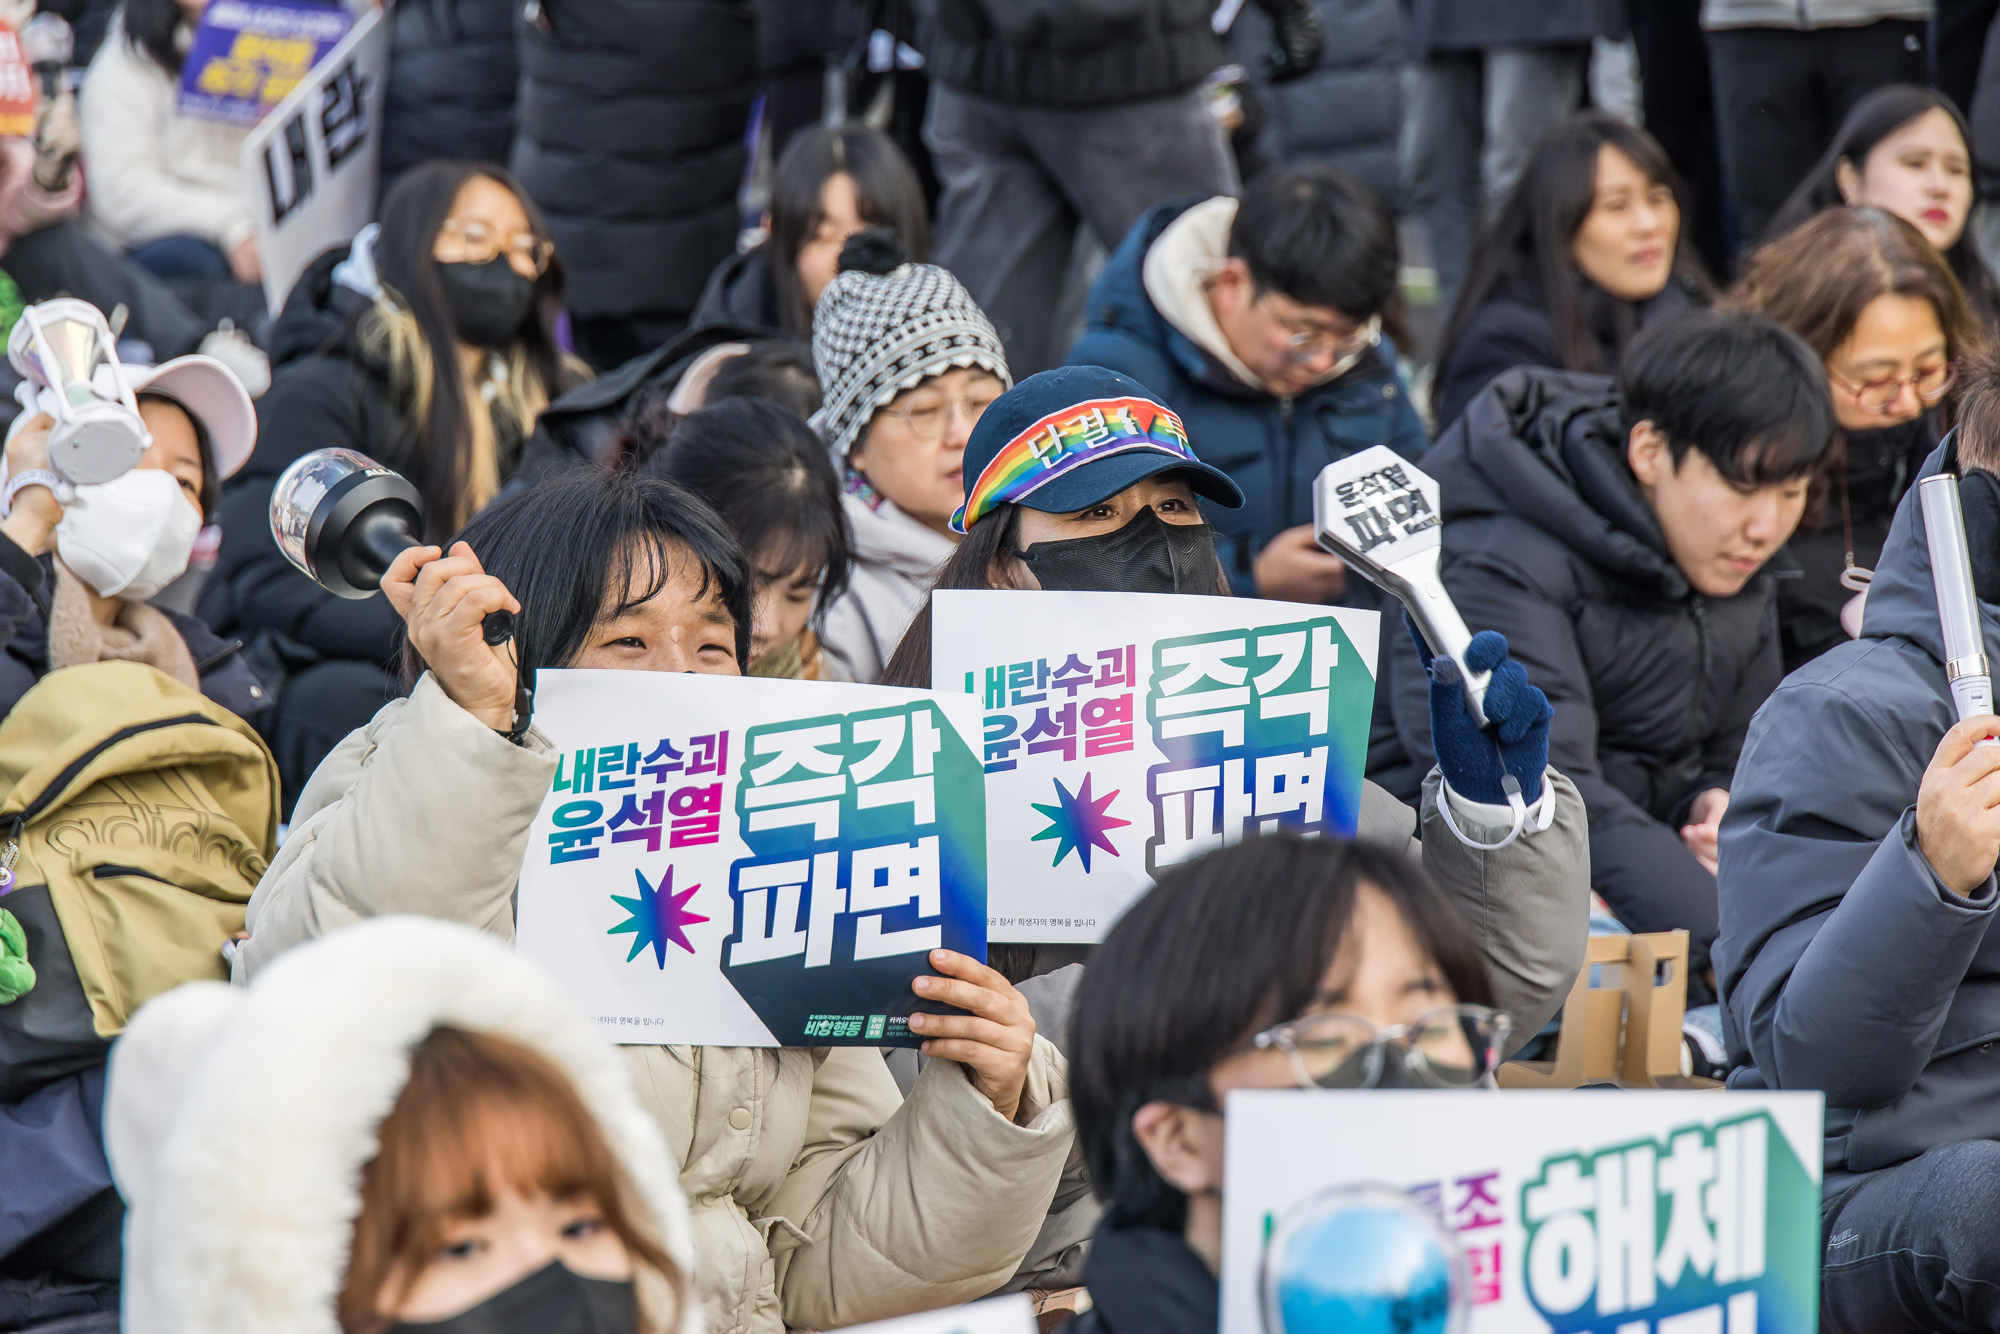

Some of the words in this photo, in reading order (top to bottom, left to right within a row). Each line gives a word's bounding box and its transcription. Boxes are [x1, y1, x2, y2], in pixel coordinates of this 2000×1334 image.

[265, 61, 368, 228] 내란
[1027, 407, 1118, 470] 단결
[1335, 462, 1411, 509] 윤석열
[1344, 488, 1440, 553] 파면
[965, 644, 1136, 711] 내란수괴
[1155, 625, 1338, 749] 즉각
[552, 729, 730, 795] 내란수괴
[983, 692, 1134, 775] 윤석열
[745, 708, 942, 842] 즉각
[1154, 745, 1329, 868] 파면
[548, 781, 724, 866] 윤석열
[729, 834, 942, 969] 파면
[1049, 918, 1072, 928] 명복을
[1074, 918, 1096, 928] 빕니다
[619, 1016, 641, 1026] 명복을
[643, 1017, 664, 1026] 빕니다
[889, 1016, 909, 1024] 카카오
[1526, 1116, 1767, 1318] 해체
